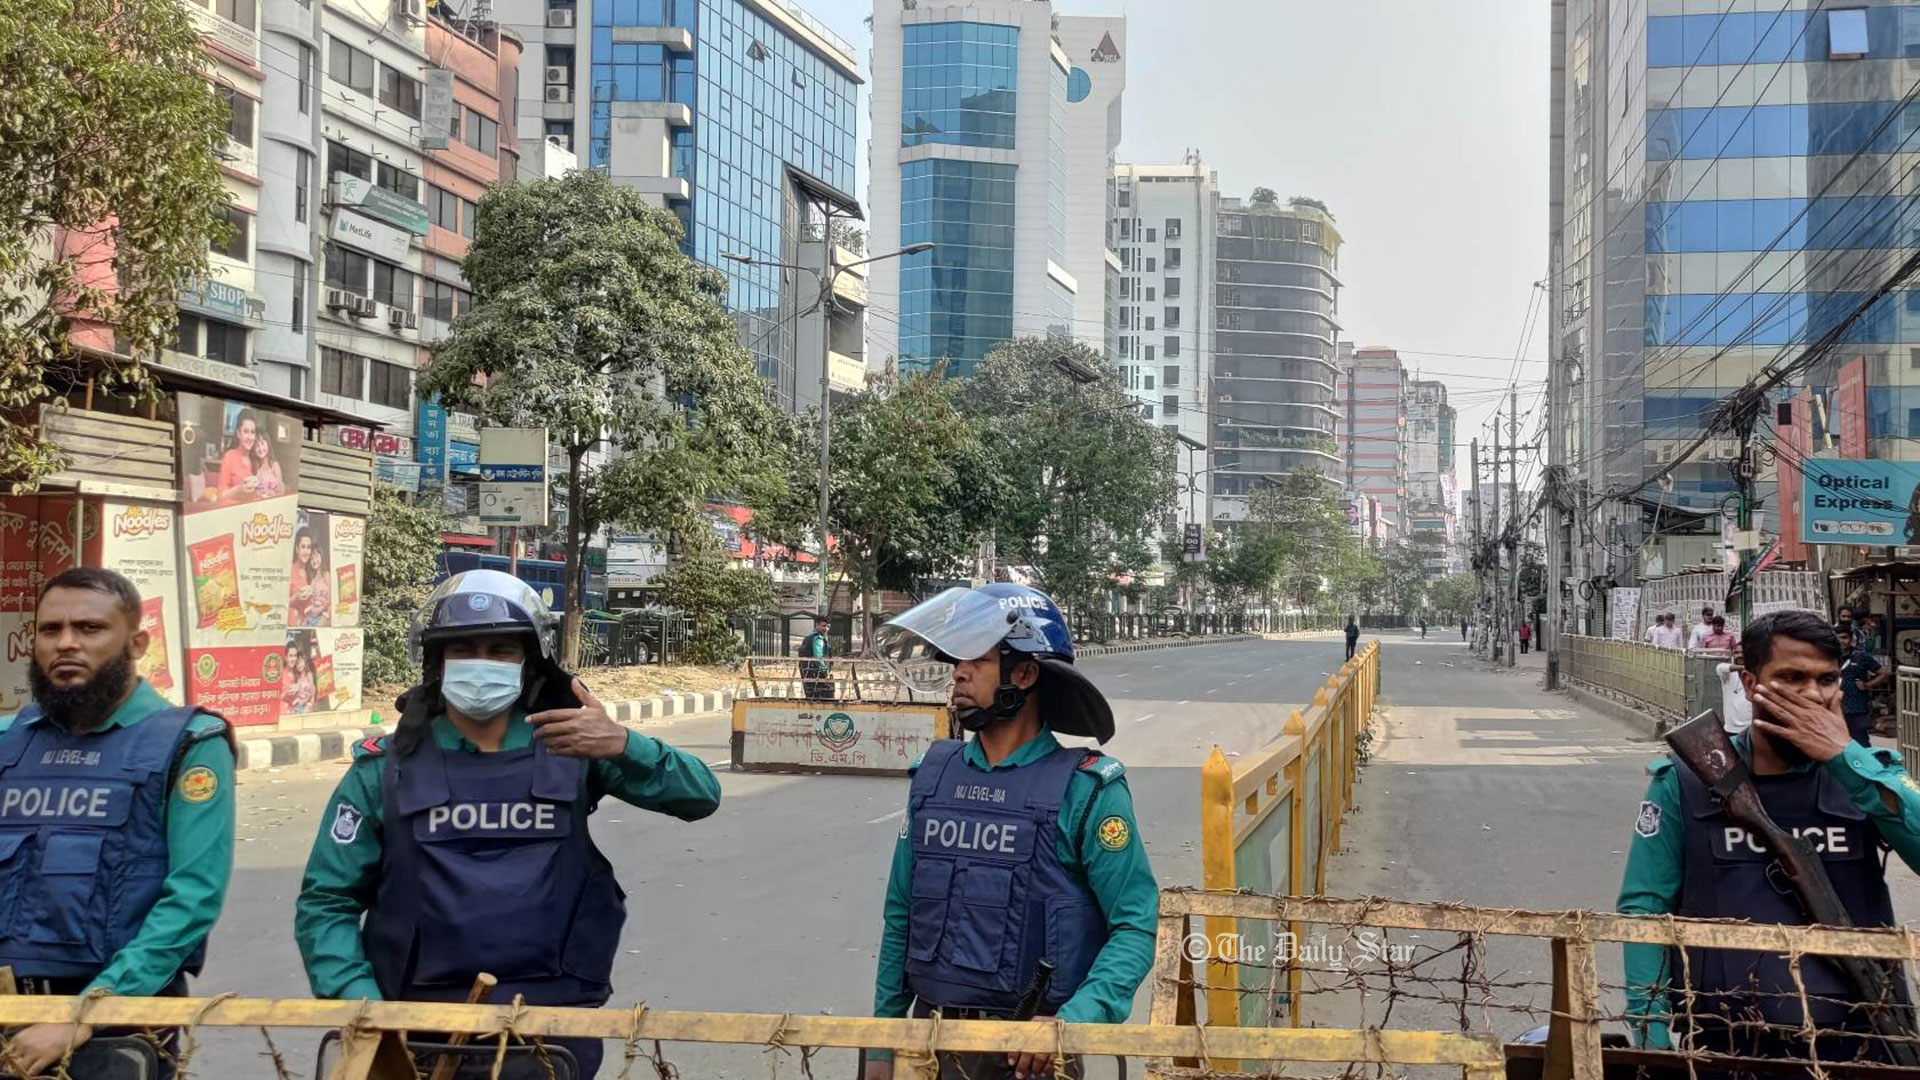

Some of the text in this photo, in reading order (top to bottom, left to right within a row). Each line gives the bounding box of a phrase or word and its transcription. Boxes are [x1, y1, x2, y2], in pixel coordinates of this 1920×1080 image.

[349, 223, 372, 239] MetLife
[210, 282, 244, 306] SHOP
[1818, 474, 1890, 491] Optical
[1814, 494, 1893, 511] Express
[114, 507, 170, 538] Noodles
[241, 513, 294, 546] Noodles
[998, 596, 1049, 611] POLICE
[1, 787, 111, 817] POLICE
[429, 803, 555, 833] POLICE
[924, 818, 1017, 853] POLICE
